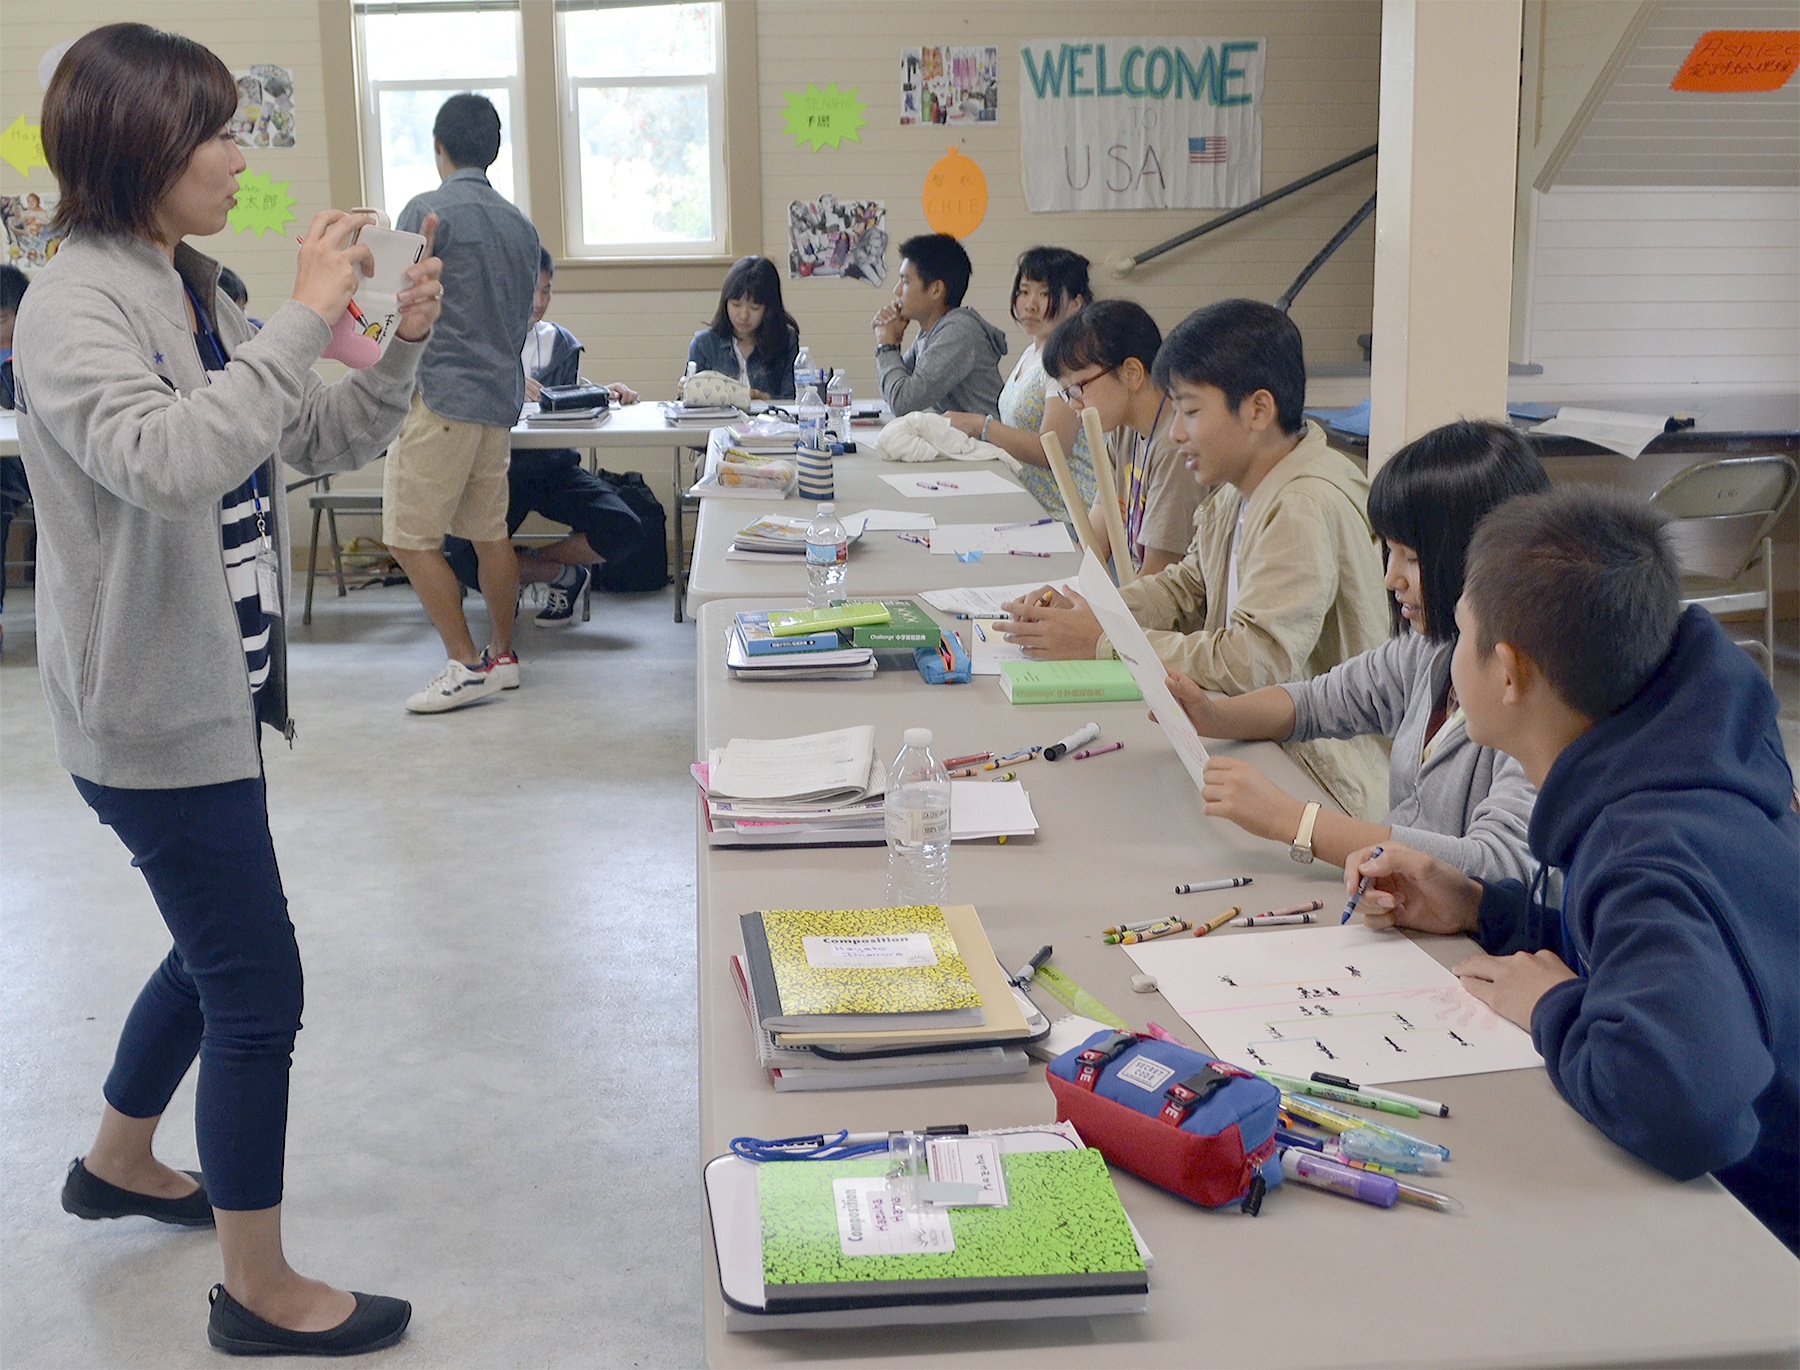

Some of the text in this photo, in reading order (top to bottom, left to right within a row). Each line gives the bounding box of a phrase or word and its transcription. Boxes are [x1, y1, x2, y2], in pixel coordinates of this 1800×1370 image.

[1021, 41, 1258, 107] WELCOME
[1063, 144, 1166, 193] USA
[822, 936, 909, 945] Composition
[1134, 1061, 1164, 1077] SECRET
[975, 1154, 993, 1191] Kazuha
[841, 1189, 865, 1242] Composition
[872, 1199, 889, 1231] Kazuha
